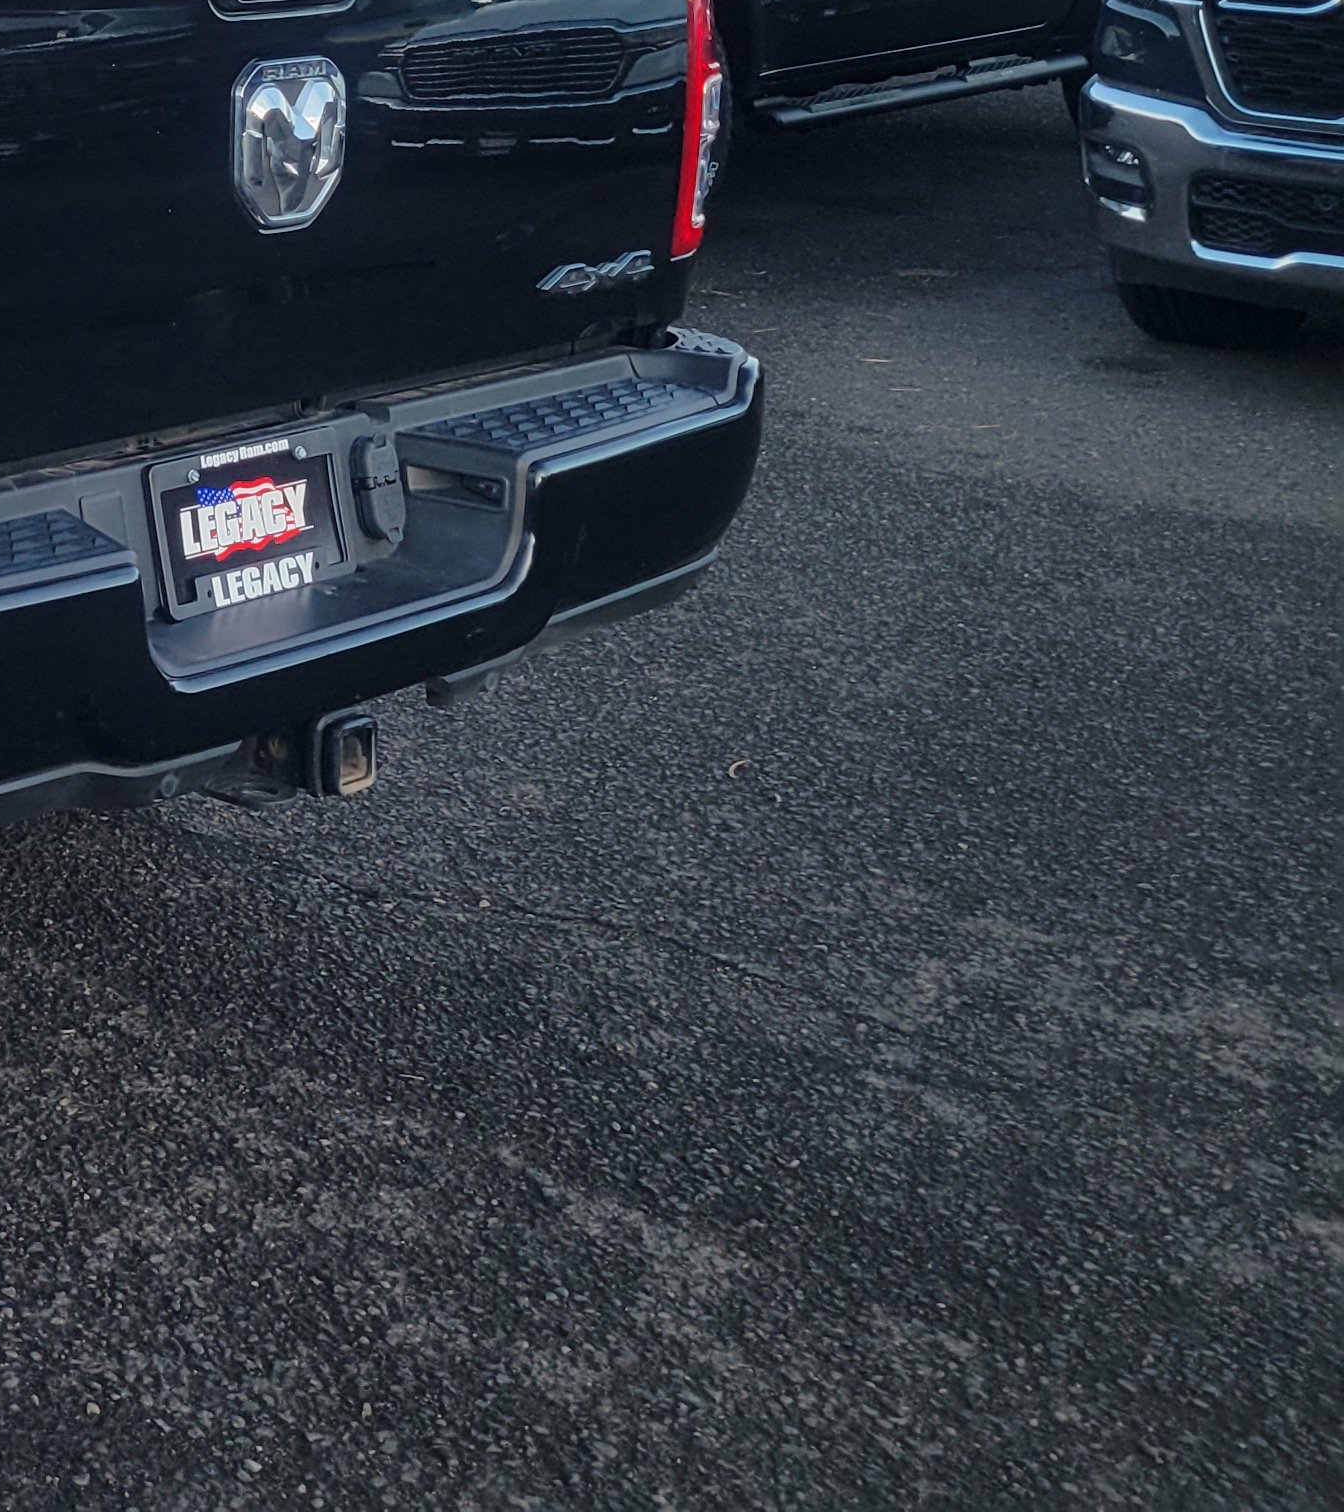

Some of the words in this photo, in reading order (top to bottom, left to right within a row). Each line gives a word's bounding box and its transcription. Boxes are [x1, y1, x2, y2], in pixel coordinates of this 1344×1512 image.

[261, 61, 327, 82] RAM
[179, 483, 308, 557] LEGACY
[211, 551, 315, 608] LEGACY
